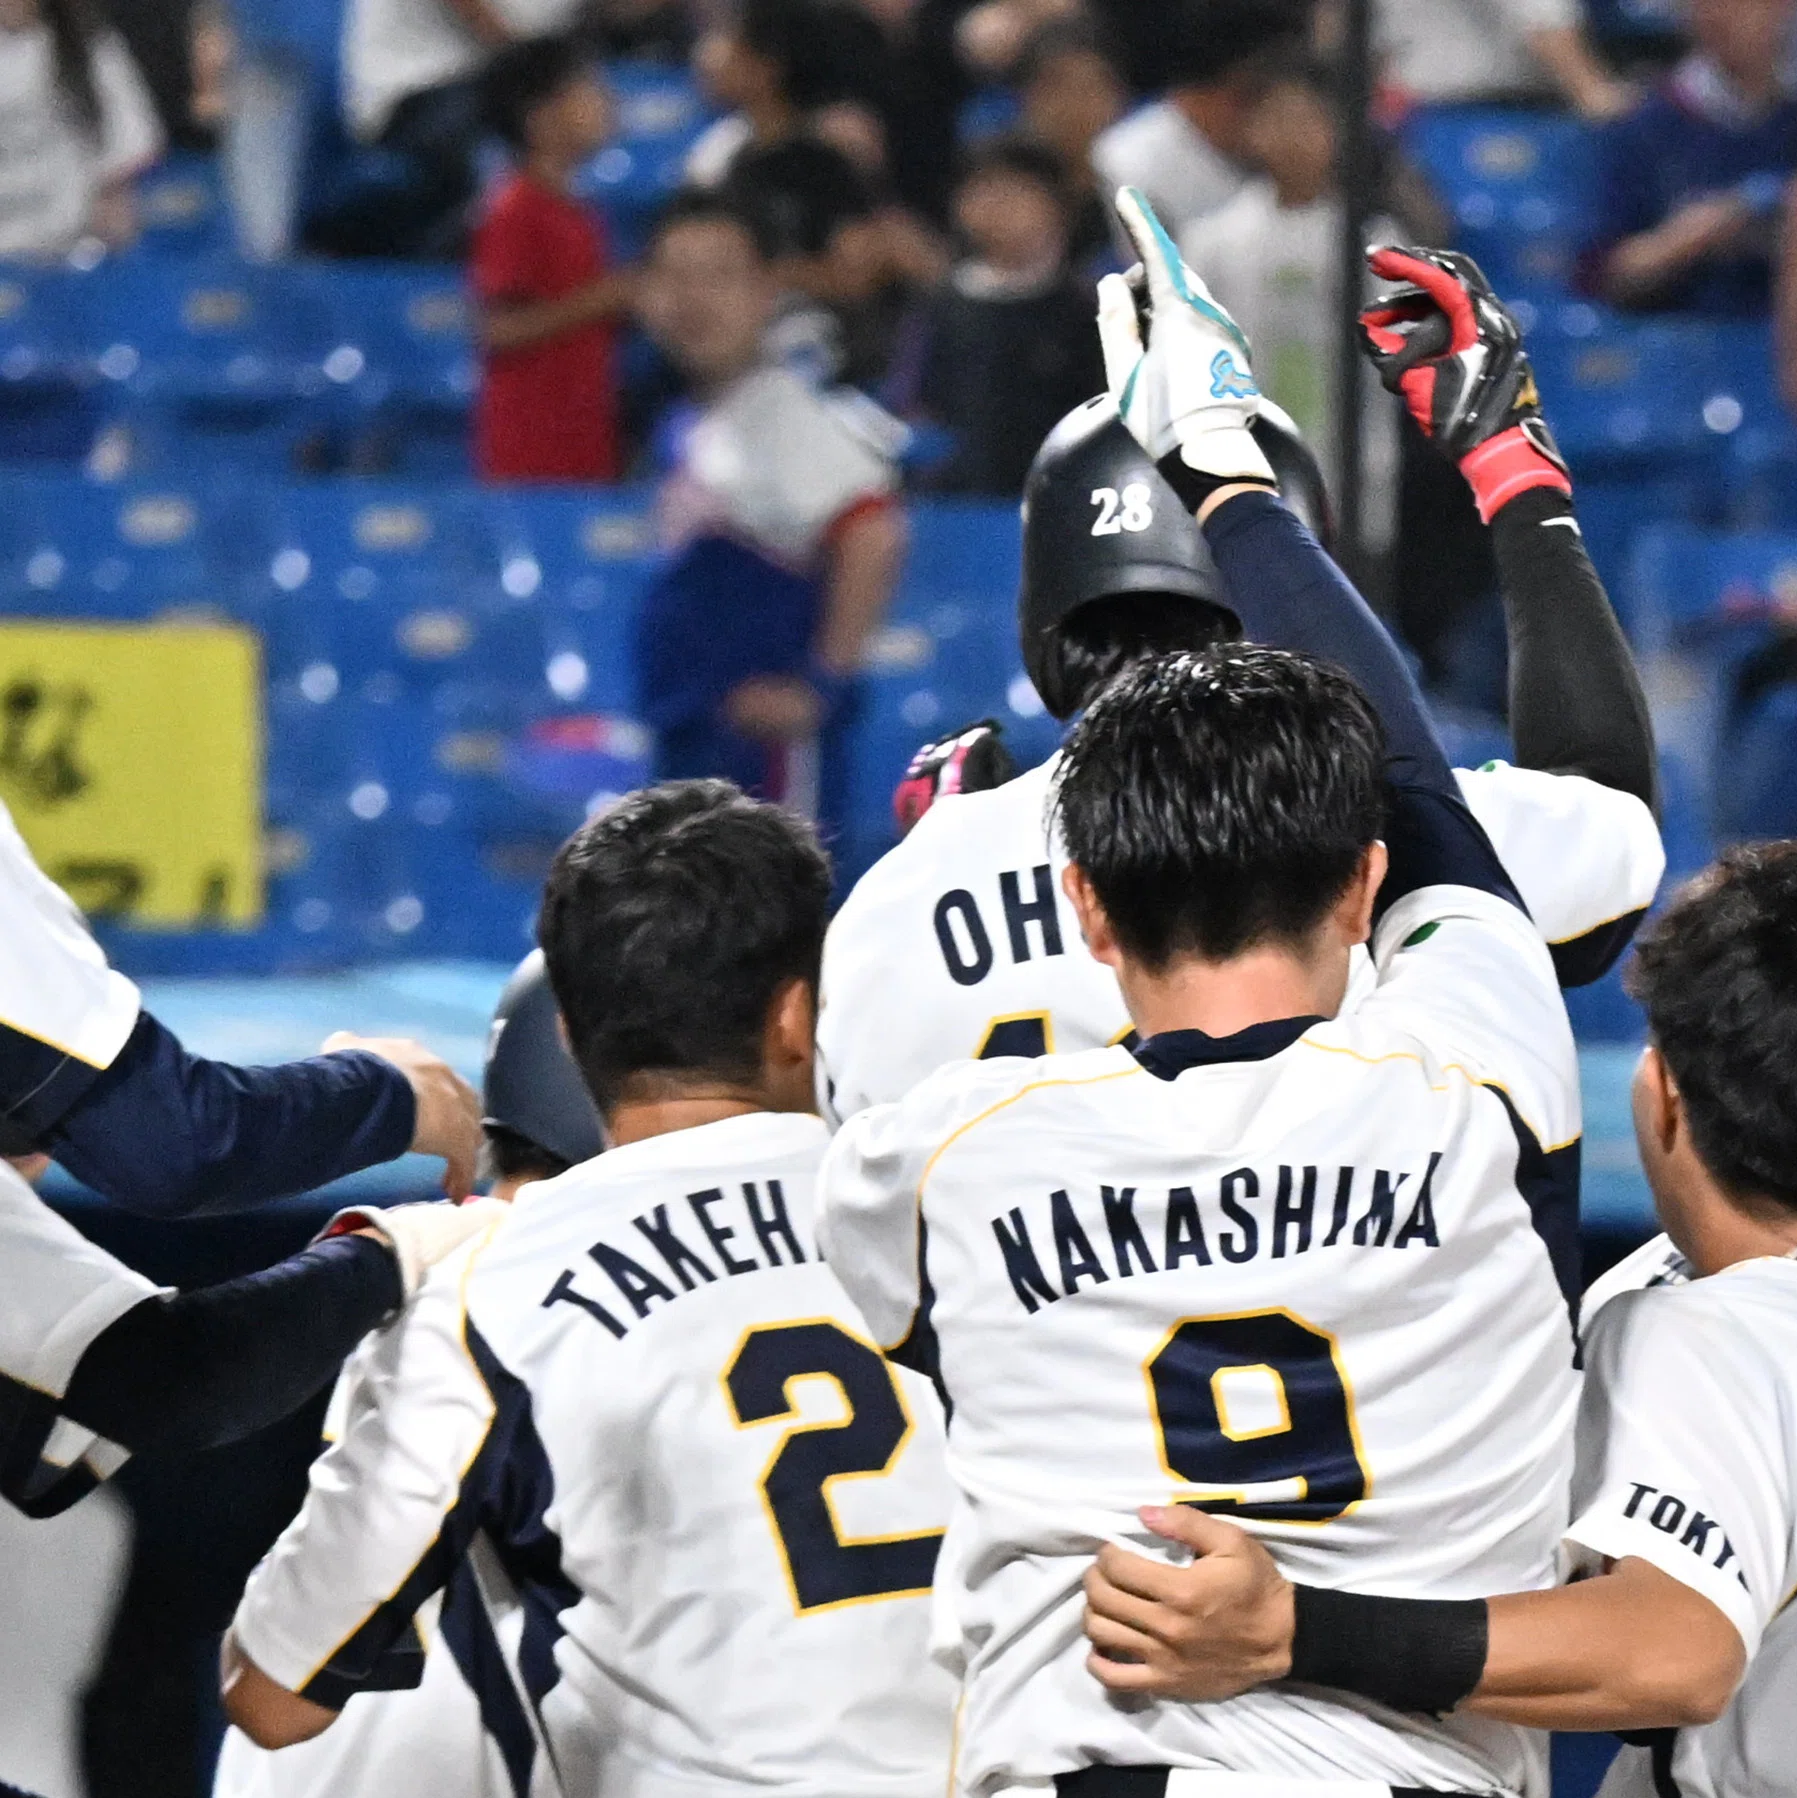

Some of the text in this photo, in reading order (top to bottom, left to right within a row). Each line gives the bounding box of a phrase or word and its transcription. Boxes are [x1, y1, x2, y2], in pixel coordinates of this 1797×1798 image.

[1089, 486, 1153, 536] 28
[541, 1179, 827, 1340] TAKEH
[991, 1151, 1443, 1315] NAKASHIMA
[718, 1315, 947, 1618] 2
[1141, 1305, 1373, 1527] 9
[1622, 1481, 1752, 1595] TOKY
